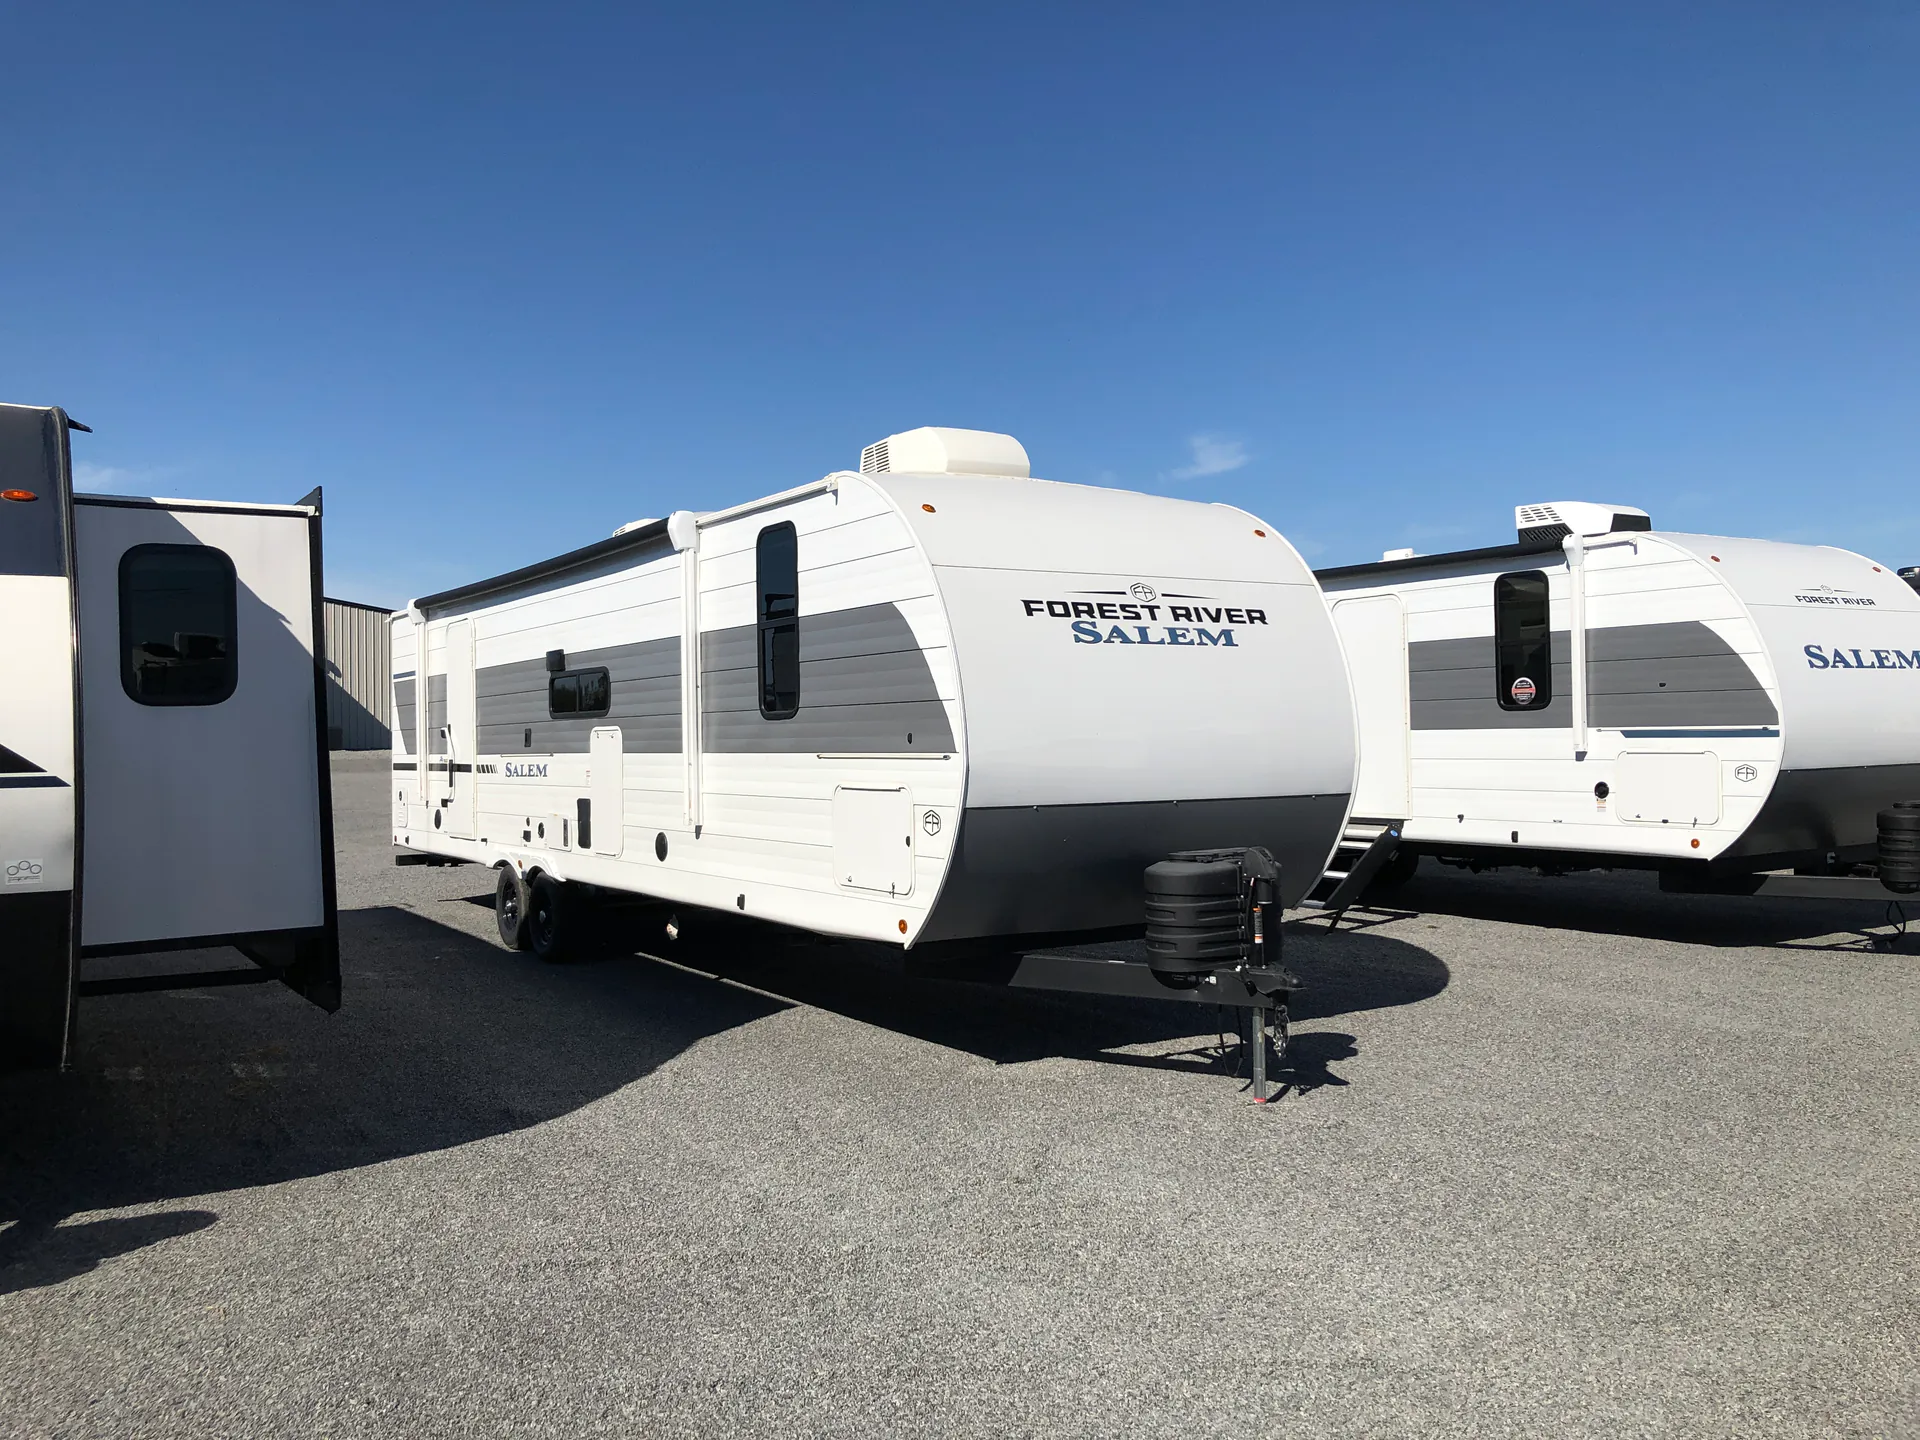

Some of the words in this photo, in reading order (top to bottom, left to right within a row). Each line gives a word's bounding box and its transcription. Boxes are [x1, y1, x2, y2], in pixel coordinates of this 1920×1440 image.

[1020, 599, 1161, 622] FOREST
[1168, 605, 1269, 625] RIVER
[1795, 595, 1841, 605] FOREST
[1841, 597, 1877, 606] RIVER
[1071, 620, 1239, 647] SALEM
[1803, 644, 1920, 669] SALEM
[505, 762, 548, 778] SALEM
